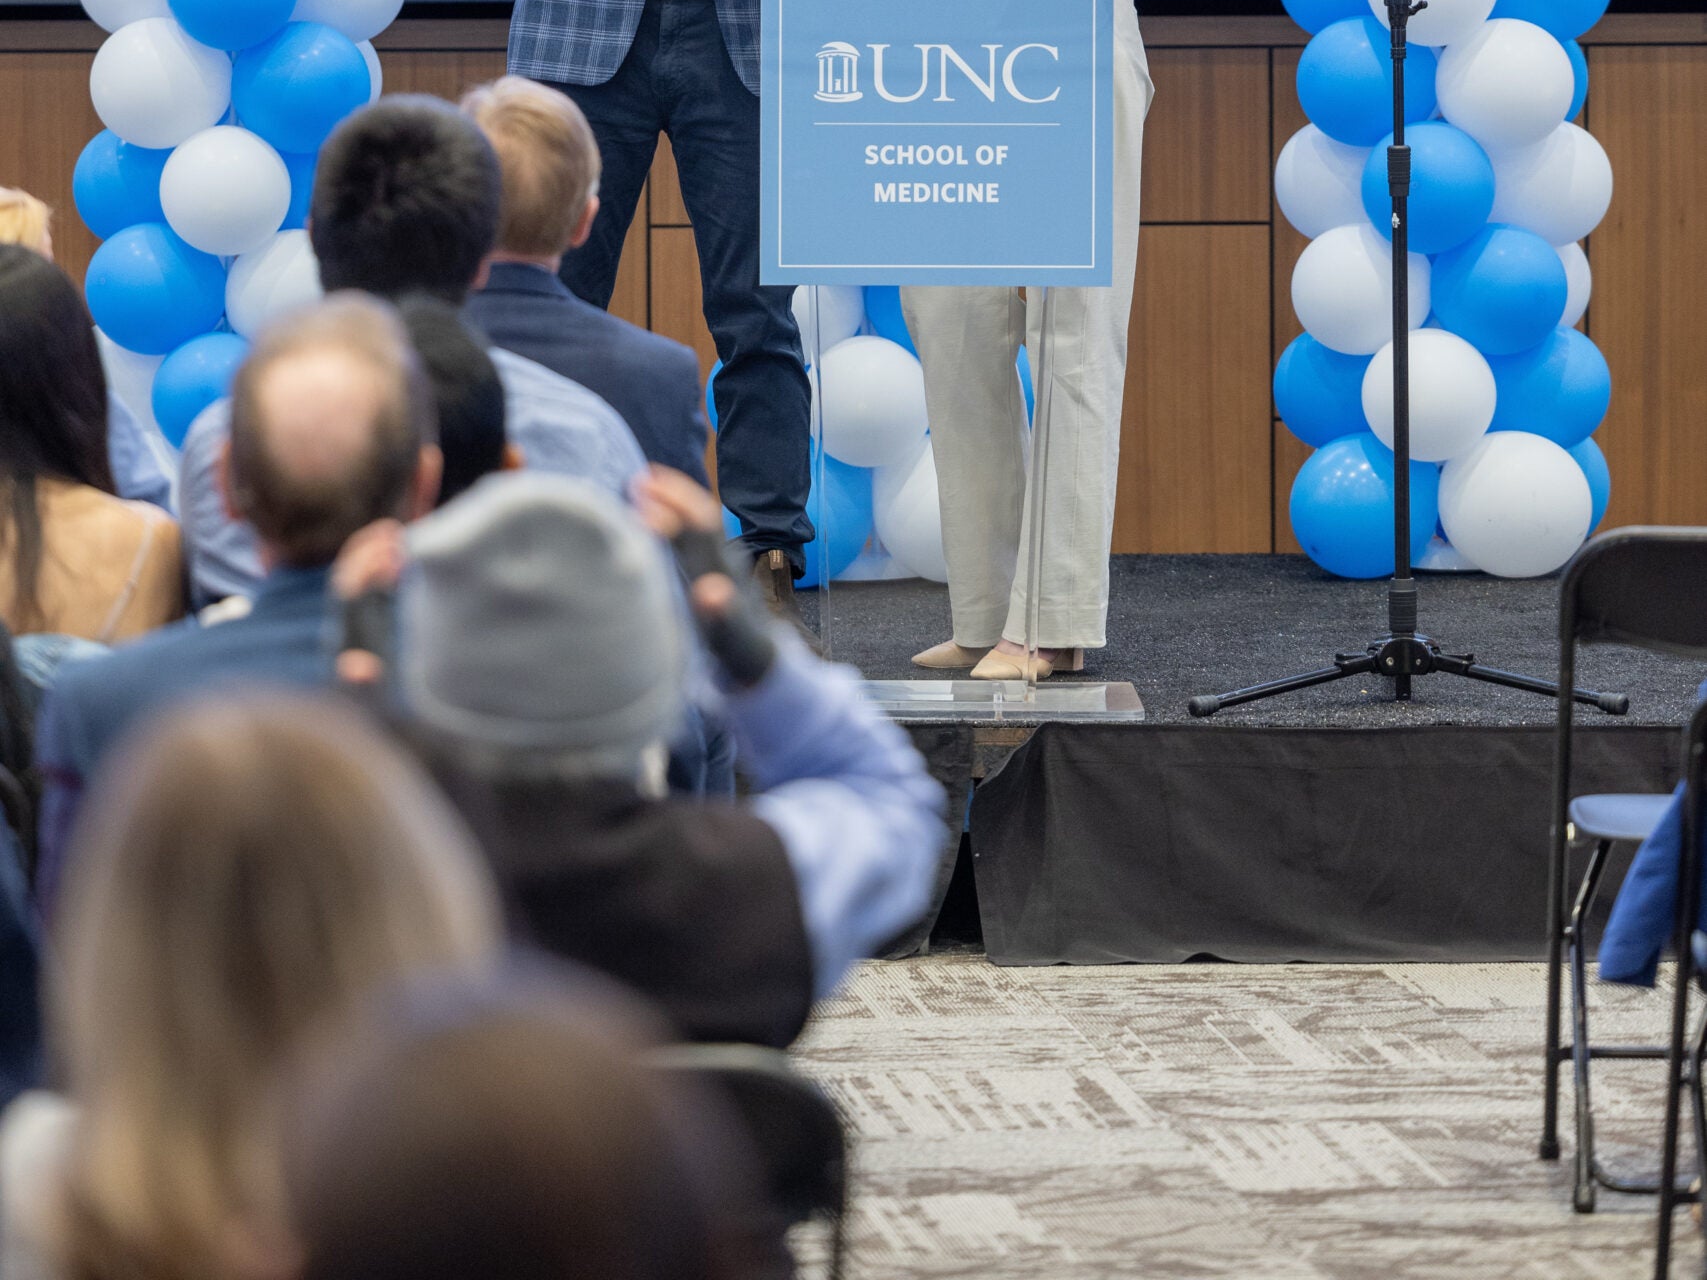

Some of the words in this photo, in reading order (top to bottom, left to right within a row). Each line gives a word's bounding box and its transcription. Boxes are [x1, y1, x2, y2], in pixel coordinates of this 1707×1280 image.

[866, 43, 1061, 103] UNC
[864, 145, 969, 166] SCHOOL
[976, 145, 1009, 165] OF
[873, 182, 1000, 203] MEDICINE
